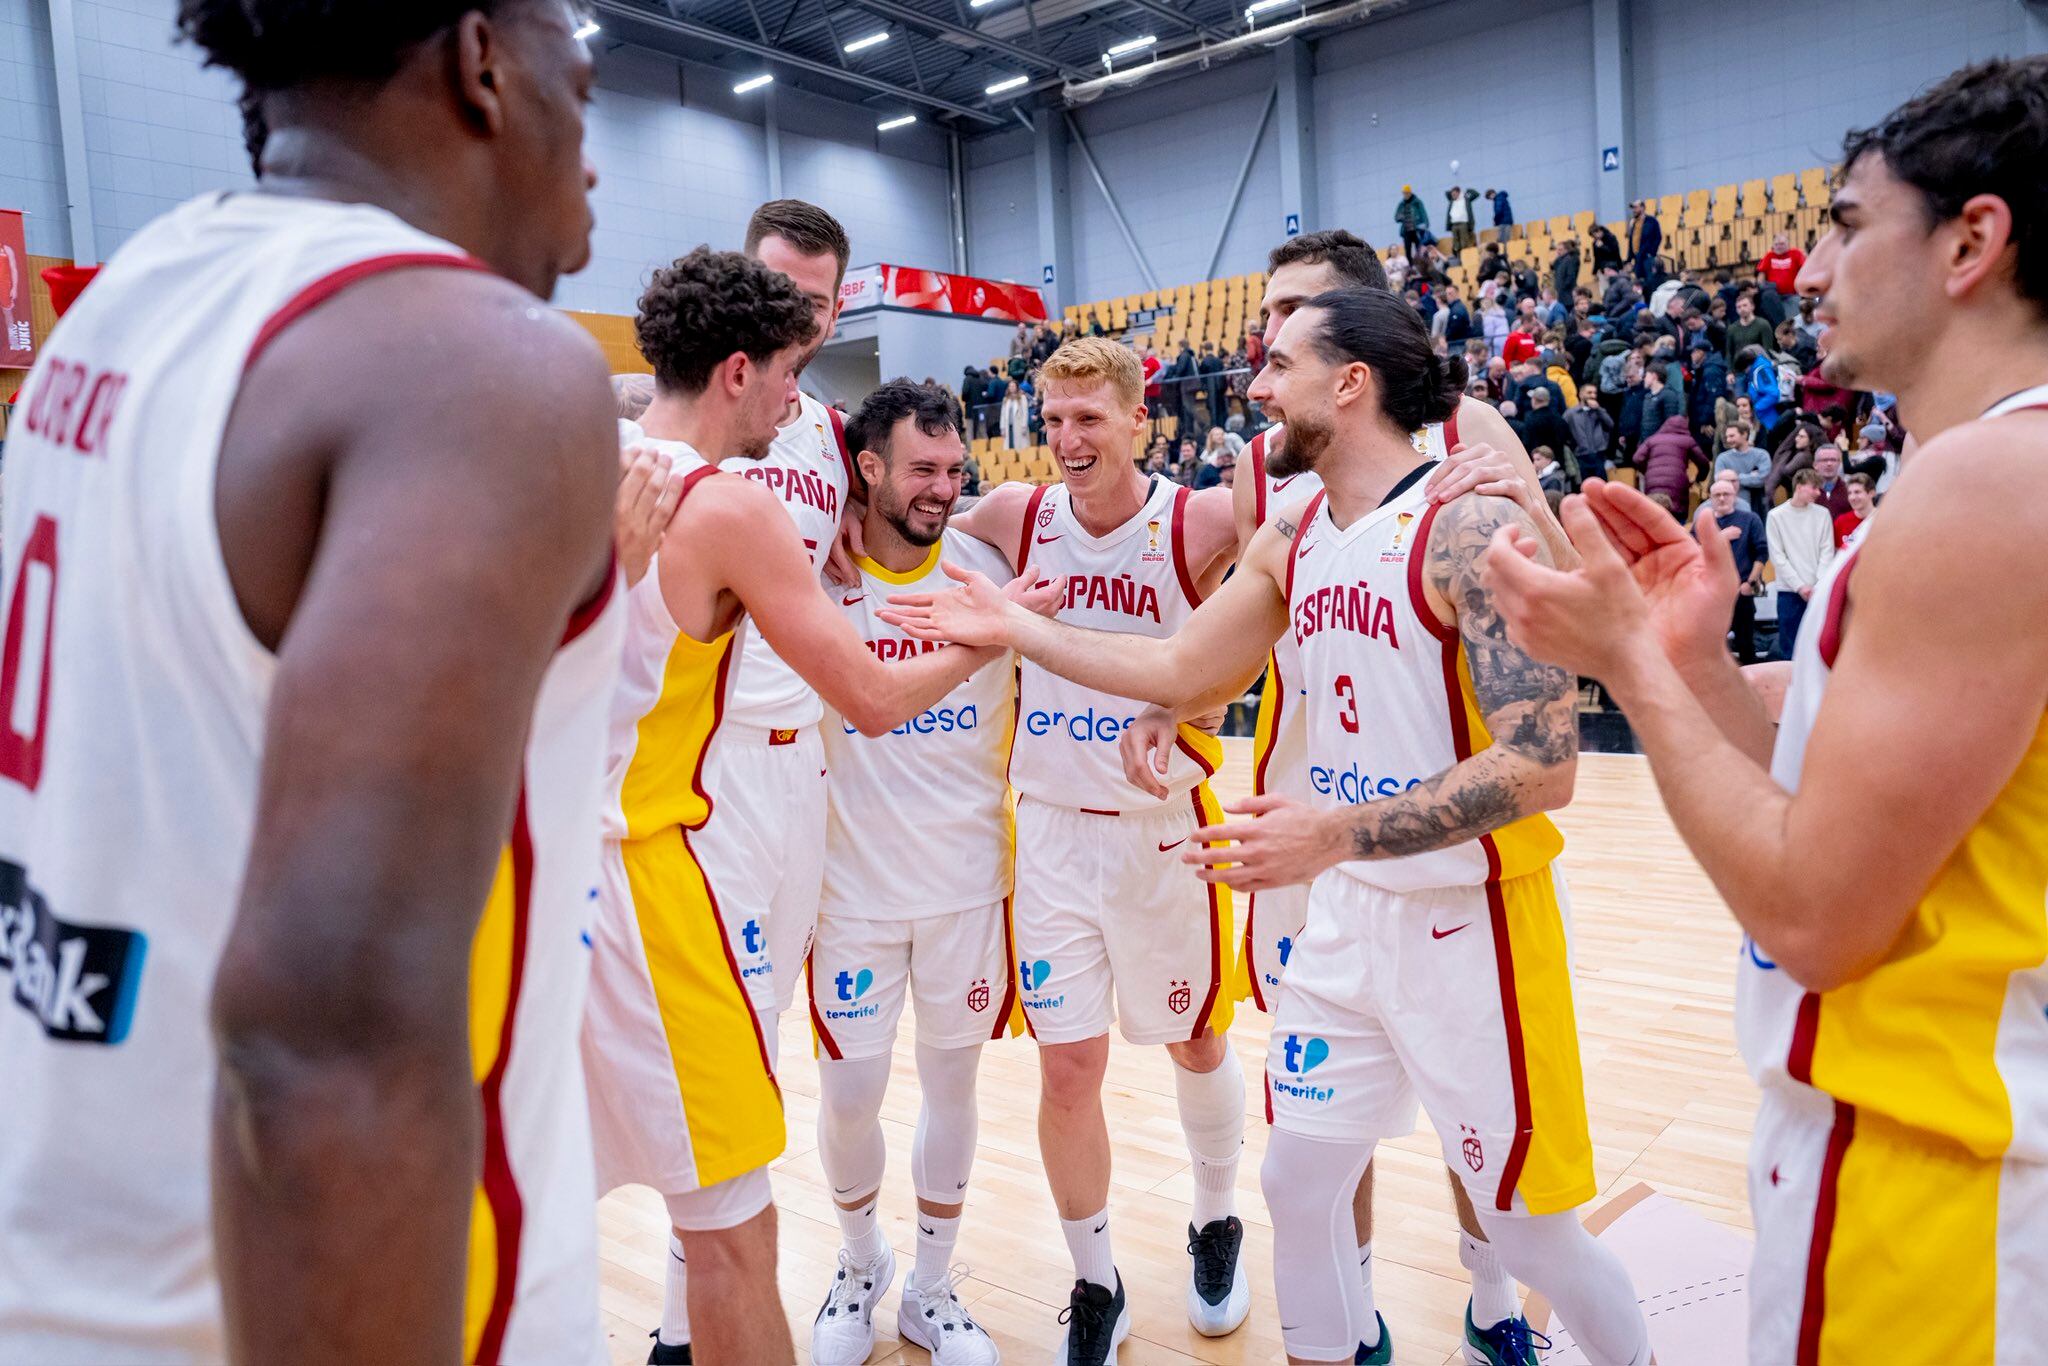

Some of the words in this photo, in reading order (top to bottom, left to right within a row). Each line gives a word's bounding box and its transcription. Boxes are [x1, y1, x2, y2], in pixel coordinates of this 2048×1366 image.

[1605, 151, 1618, 168] A
[1288, 218, 1298, 232] A
[1295, 580, 1400, 651] ESPAÑA
[1334, 675, 1359, 734] 3
